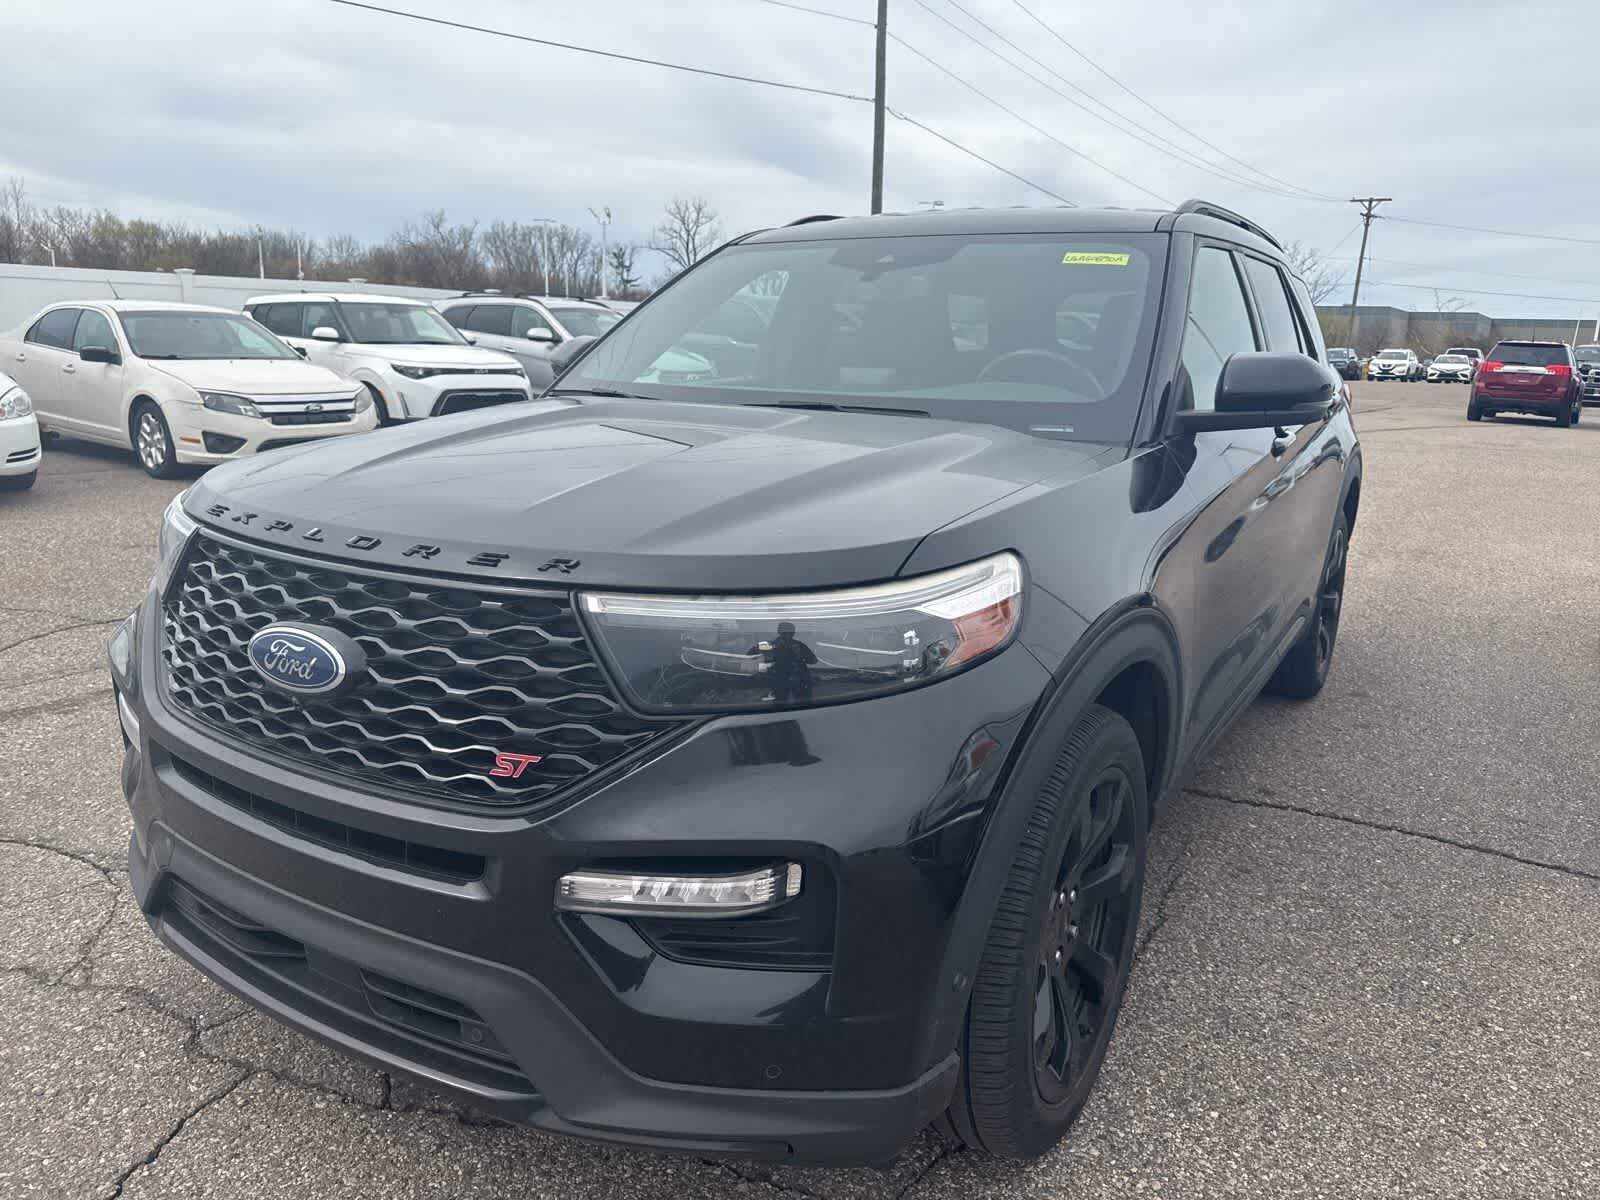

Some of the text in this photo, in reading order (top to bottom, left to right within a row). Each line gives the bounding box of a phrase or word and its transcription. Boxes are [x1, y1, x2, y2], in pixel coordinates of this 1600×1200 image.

[205, 504, 581, 574] EXPLORER
[264, 639, 317, 679] Ford
[489, 752, 542, 778] ST
